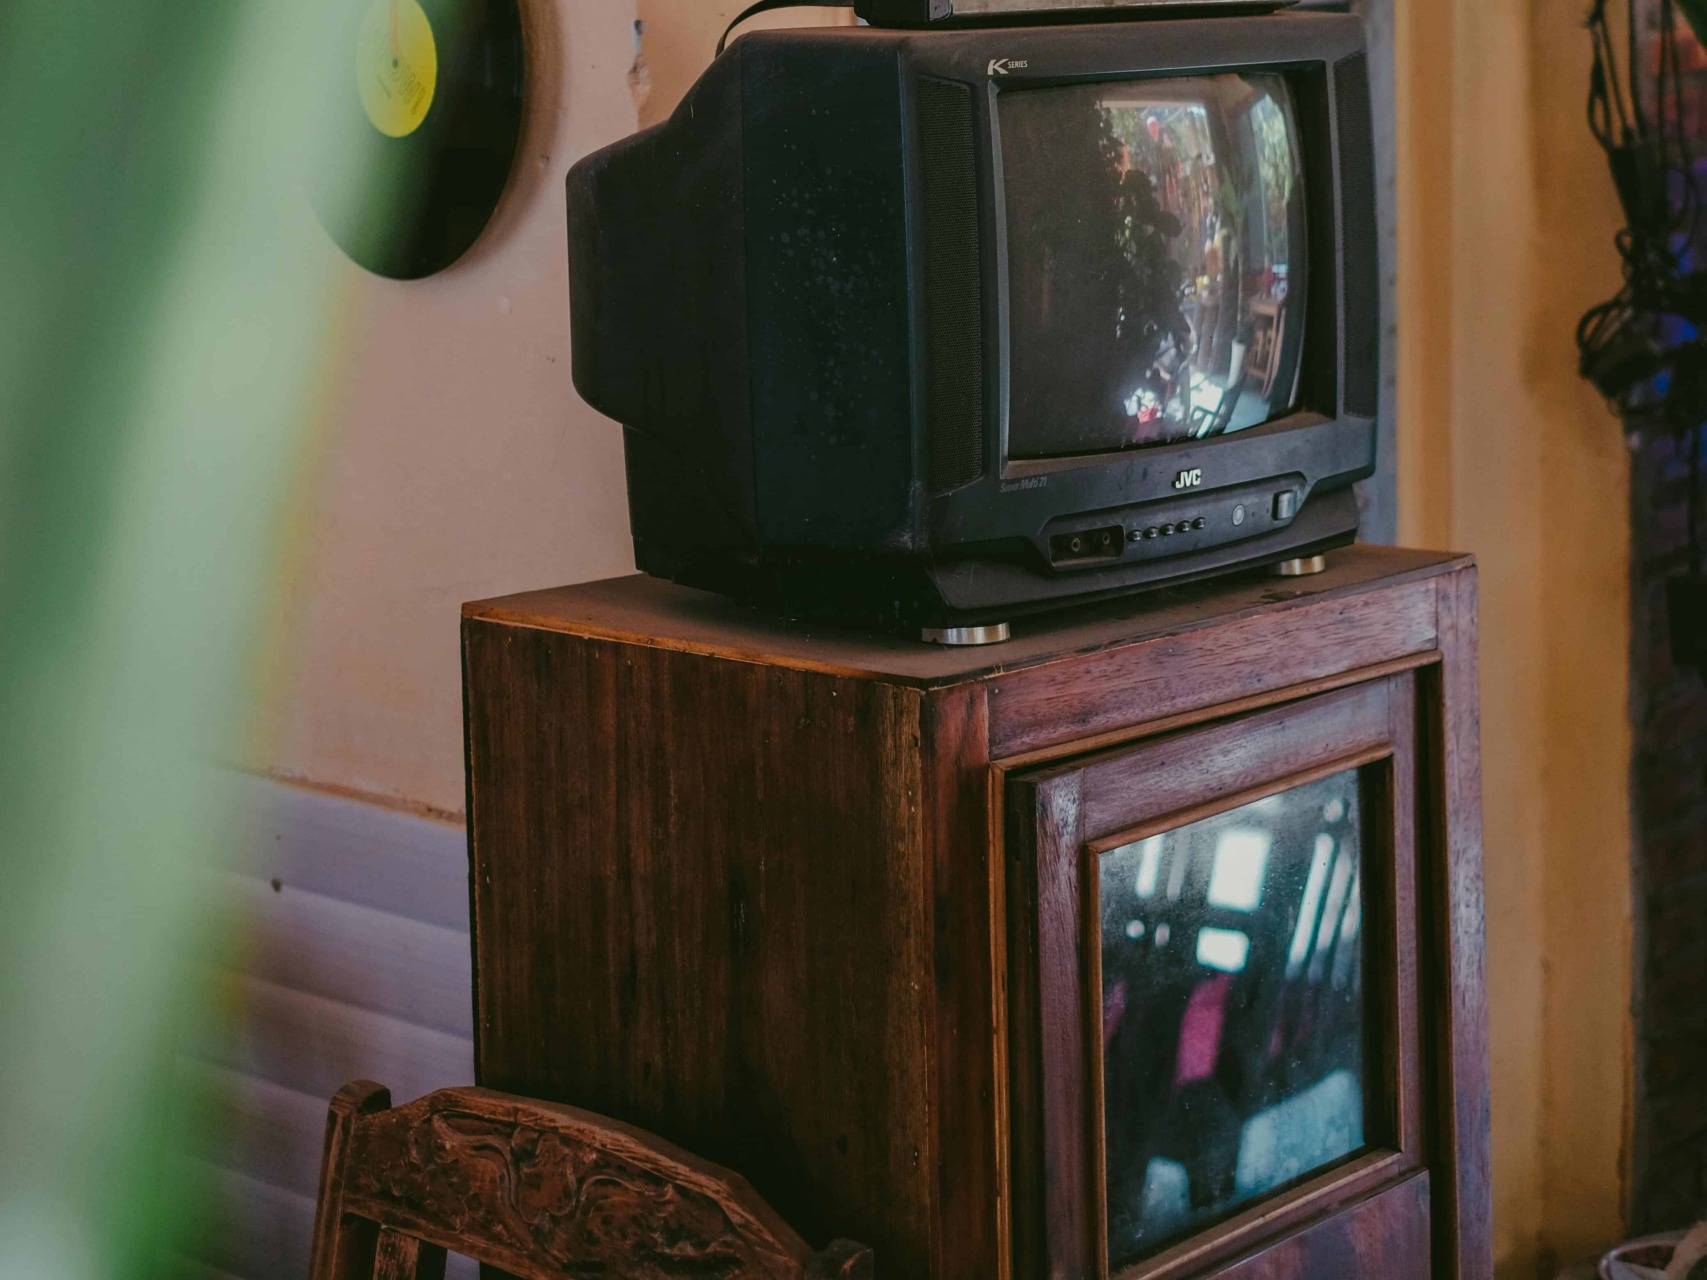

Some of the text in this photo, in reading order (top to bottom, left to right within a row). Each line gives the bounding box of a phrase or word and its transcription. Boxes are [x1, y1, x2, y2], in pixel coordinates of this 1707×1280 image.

[987, 58, 1028, 76] K SERIES
[1175, 468, 1202, 489] JVC
